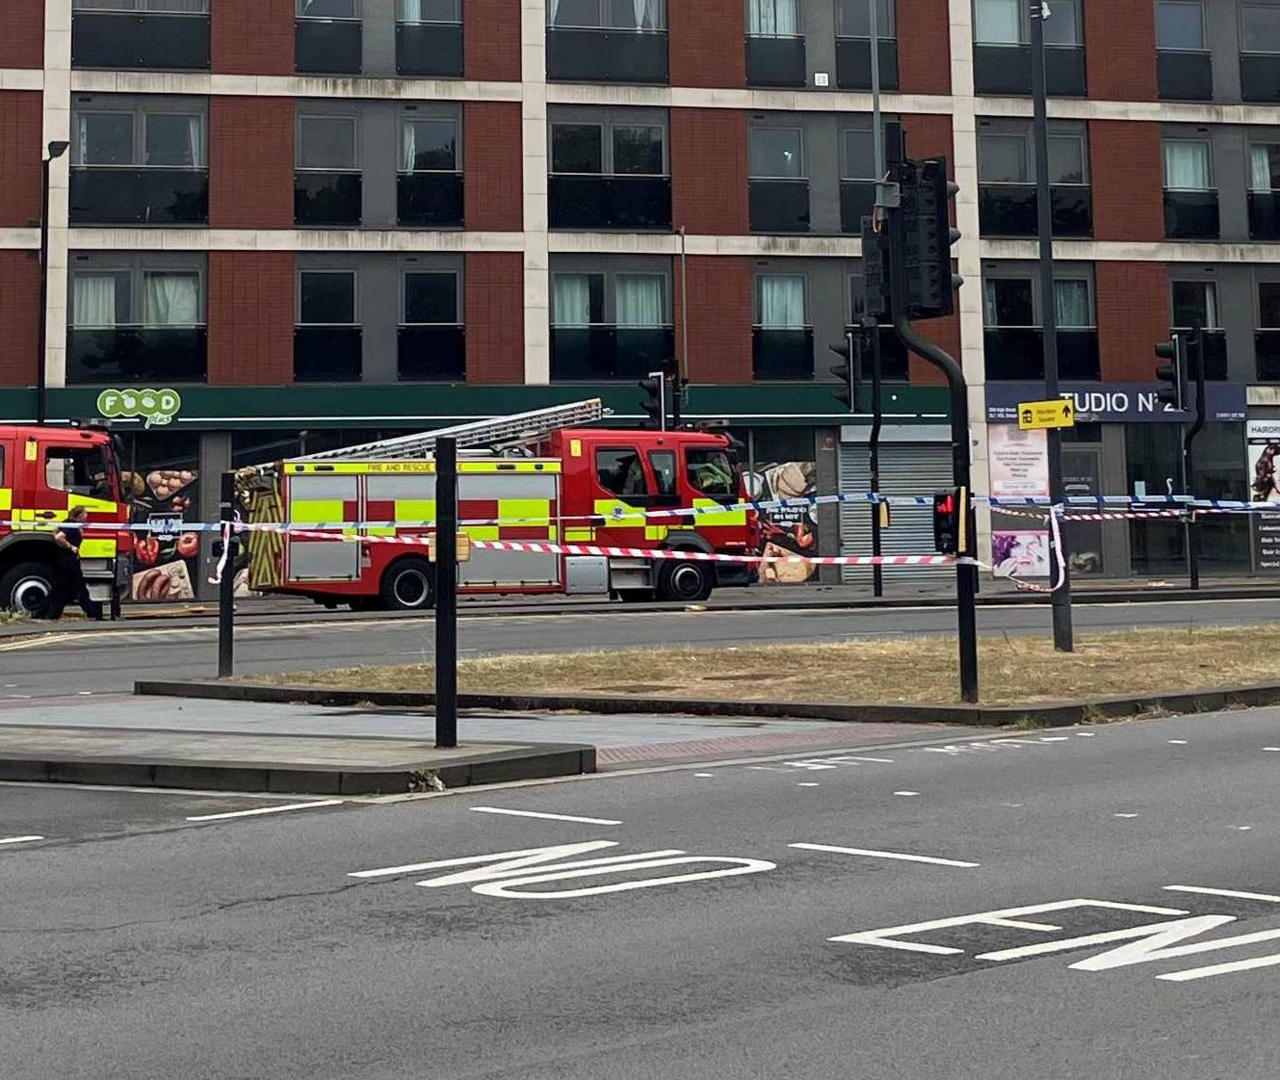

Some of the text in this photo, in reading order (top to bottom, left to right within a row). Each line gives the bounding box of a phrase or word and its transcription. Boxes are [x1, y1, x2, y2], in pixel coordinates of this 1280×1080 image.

[105, 393, 175, 411] FOOD
[368, 463, 431, 472] FIRE AND RESCUE
[347, 840, 778, 899] NO
